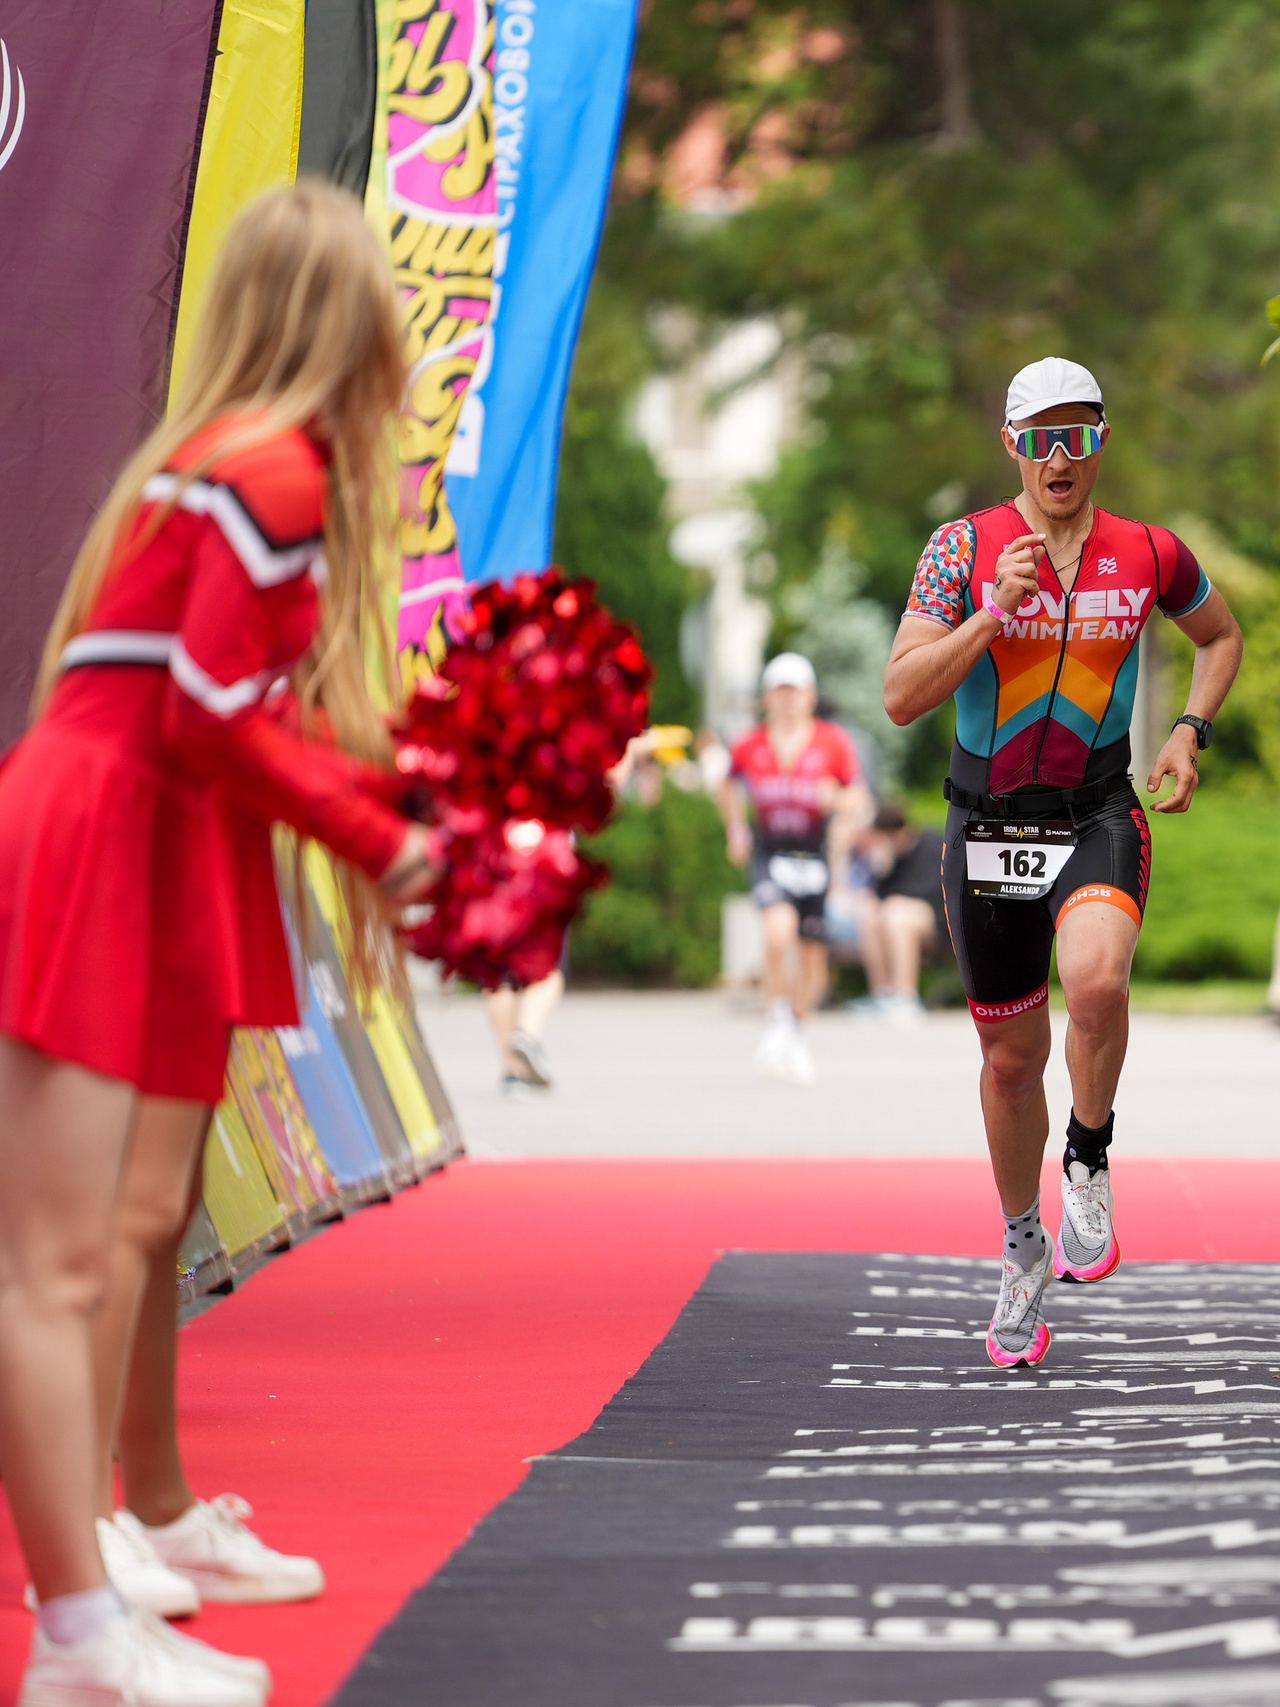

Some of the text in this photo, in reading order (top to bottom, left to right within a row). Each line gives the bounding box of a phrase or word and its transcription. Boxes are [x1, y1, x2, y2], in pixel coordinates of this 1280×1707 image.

[996, 619, 1140, 641] WIMTEAM
[1023, 826, 1039, 834] STAR
[997, 849, 1047, 879] 162
[1000, 884, 1040, 895] ALEKSANDR
[830, 1377, 1128, 1388] IRON
